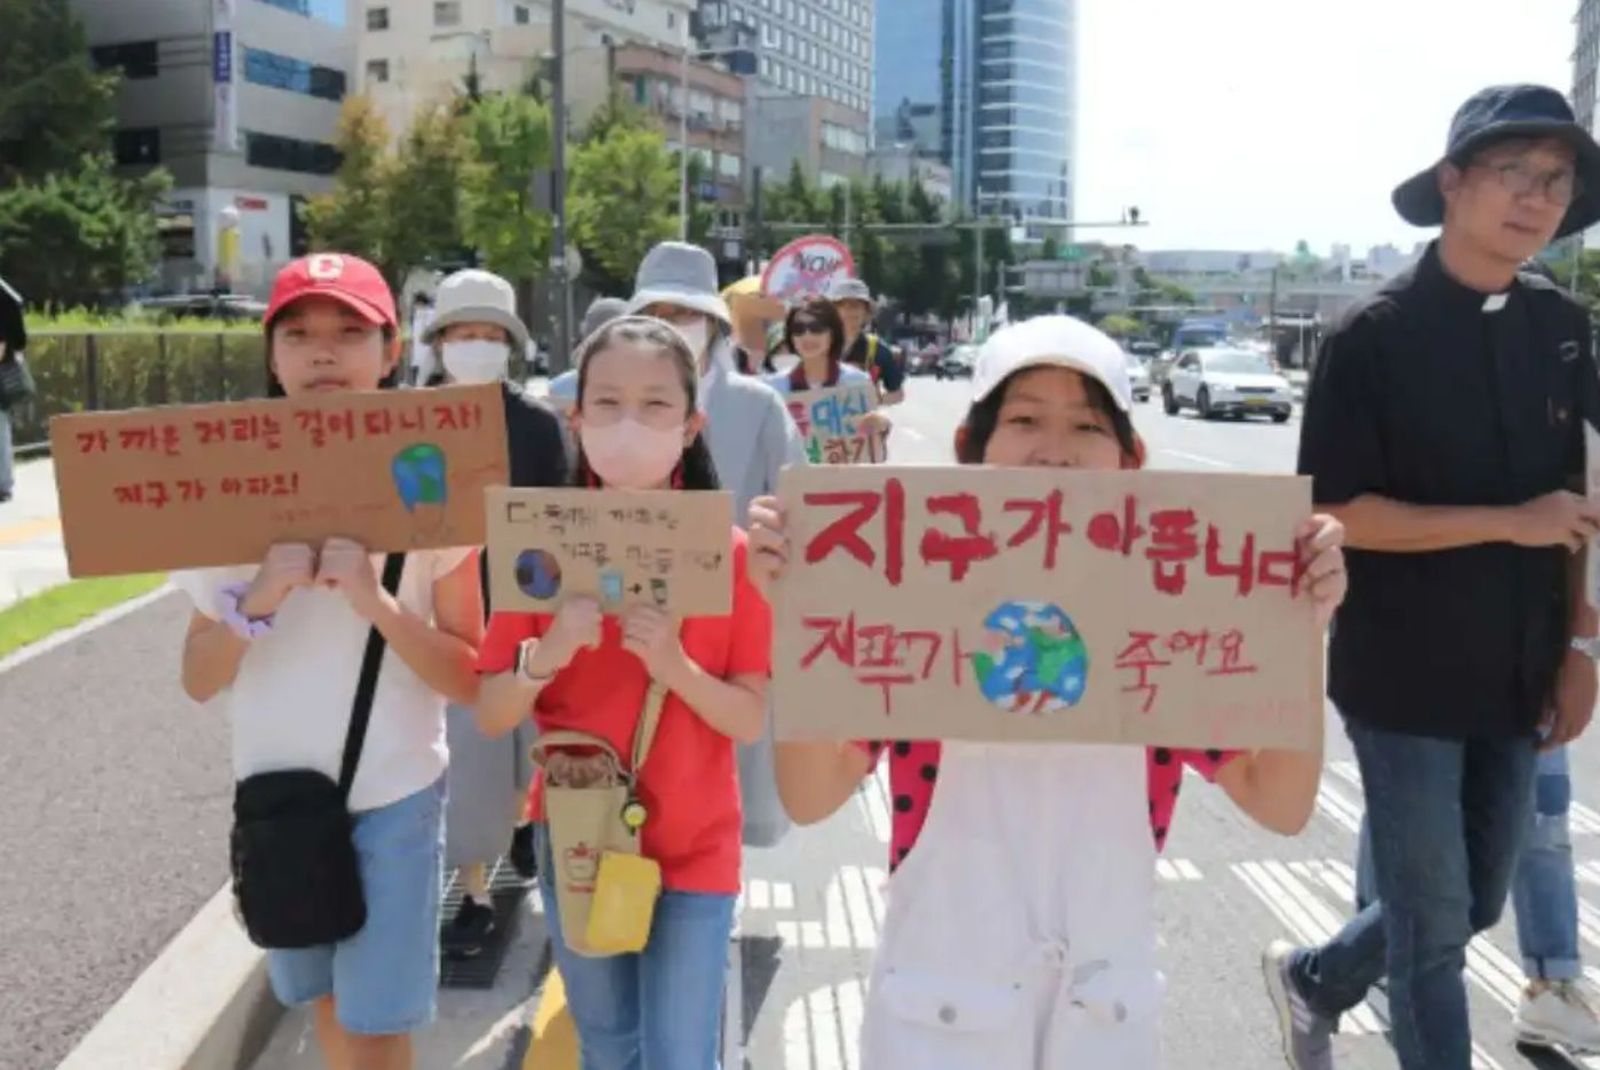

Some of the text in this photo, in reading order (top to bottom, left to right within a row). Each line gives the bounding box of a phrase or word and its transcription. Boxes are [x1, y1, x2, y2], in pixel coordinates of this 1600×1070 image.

[309, 253, 344, 279] C
[194, 413, 281, 450] 거리는
[113, 478, 206, 508] 지구가
[802, 477, 1304, 600] 지구가 아픕니다
[1115, 627, 1258, 713] 죽어요
